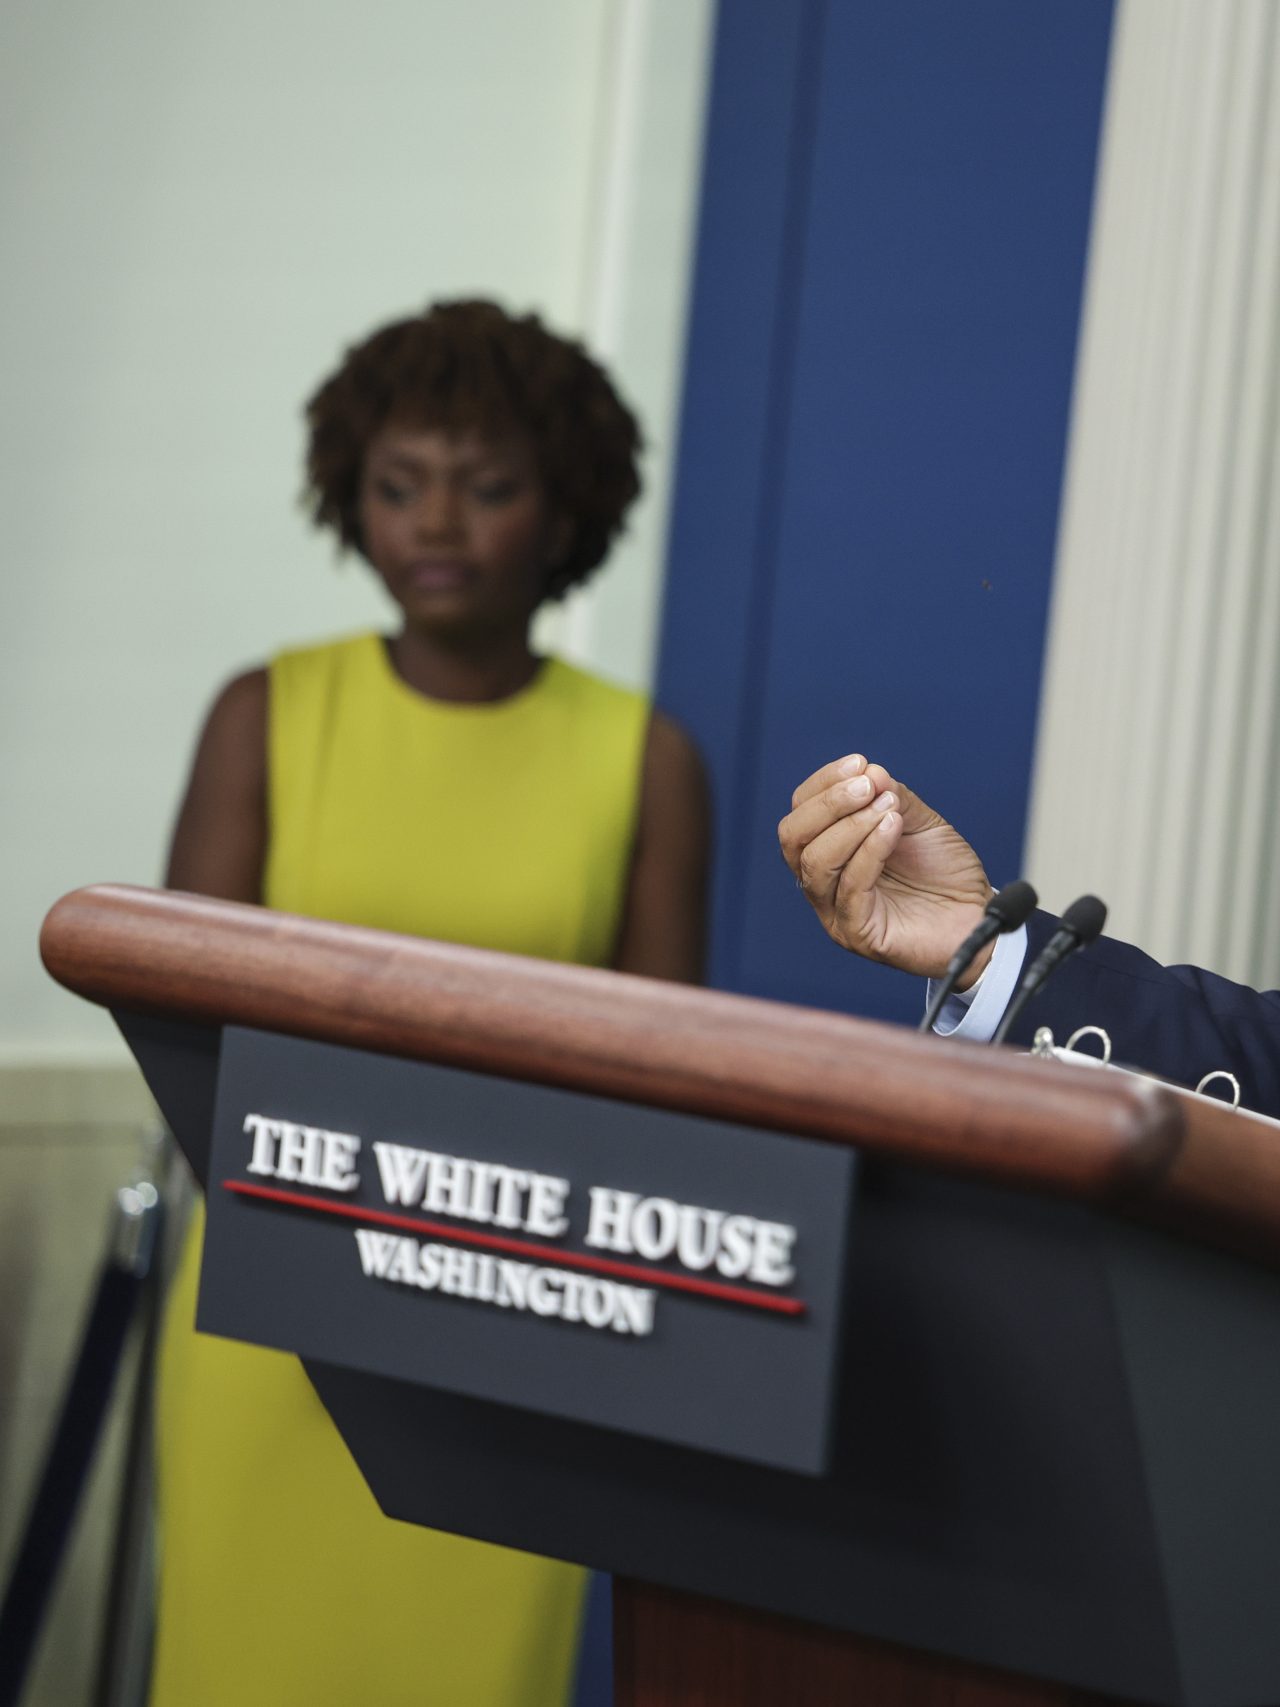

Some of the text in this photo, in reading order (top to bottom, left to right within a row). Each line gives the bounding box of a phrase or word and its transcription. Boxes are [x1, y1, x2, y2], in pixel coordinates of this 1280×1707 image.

[243, 1114, 797, 1286] THE WHITE HOUSE
[355, 1228, 654, 1335] WASHINGTON
